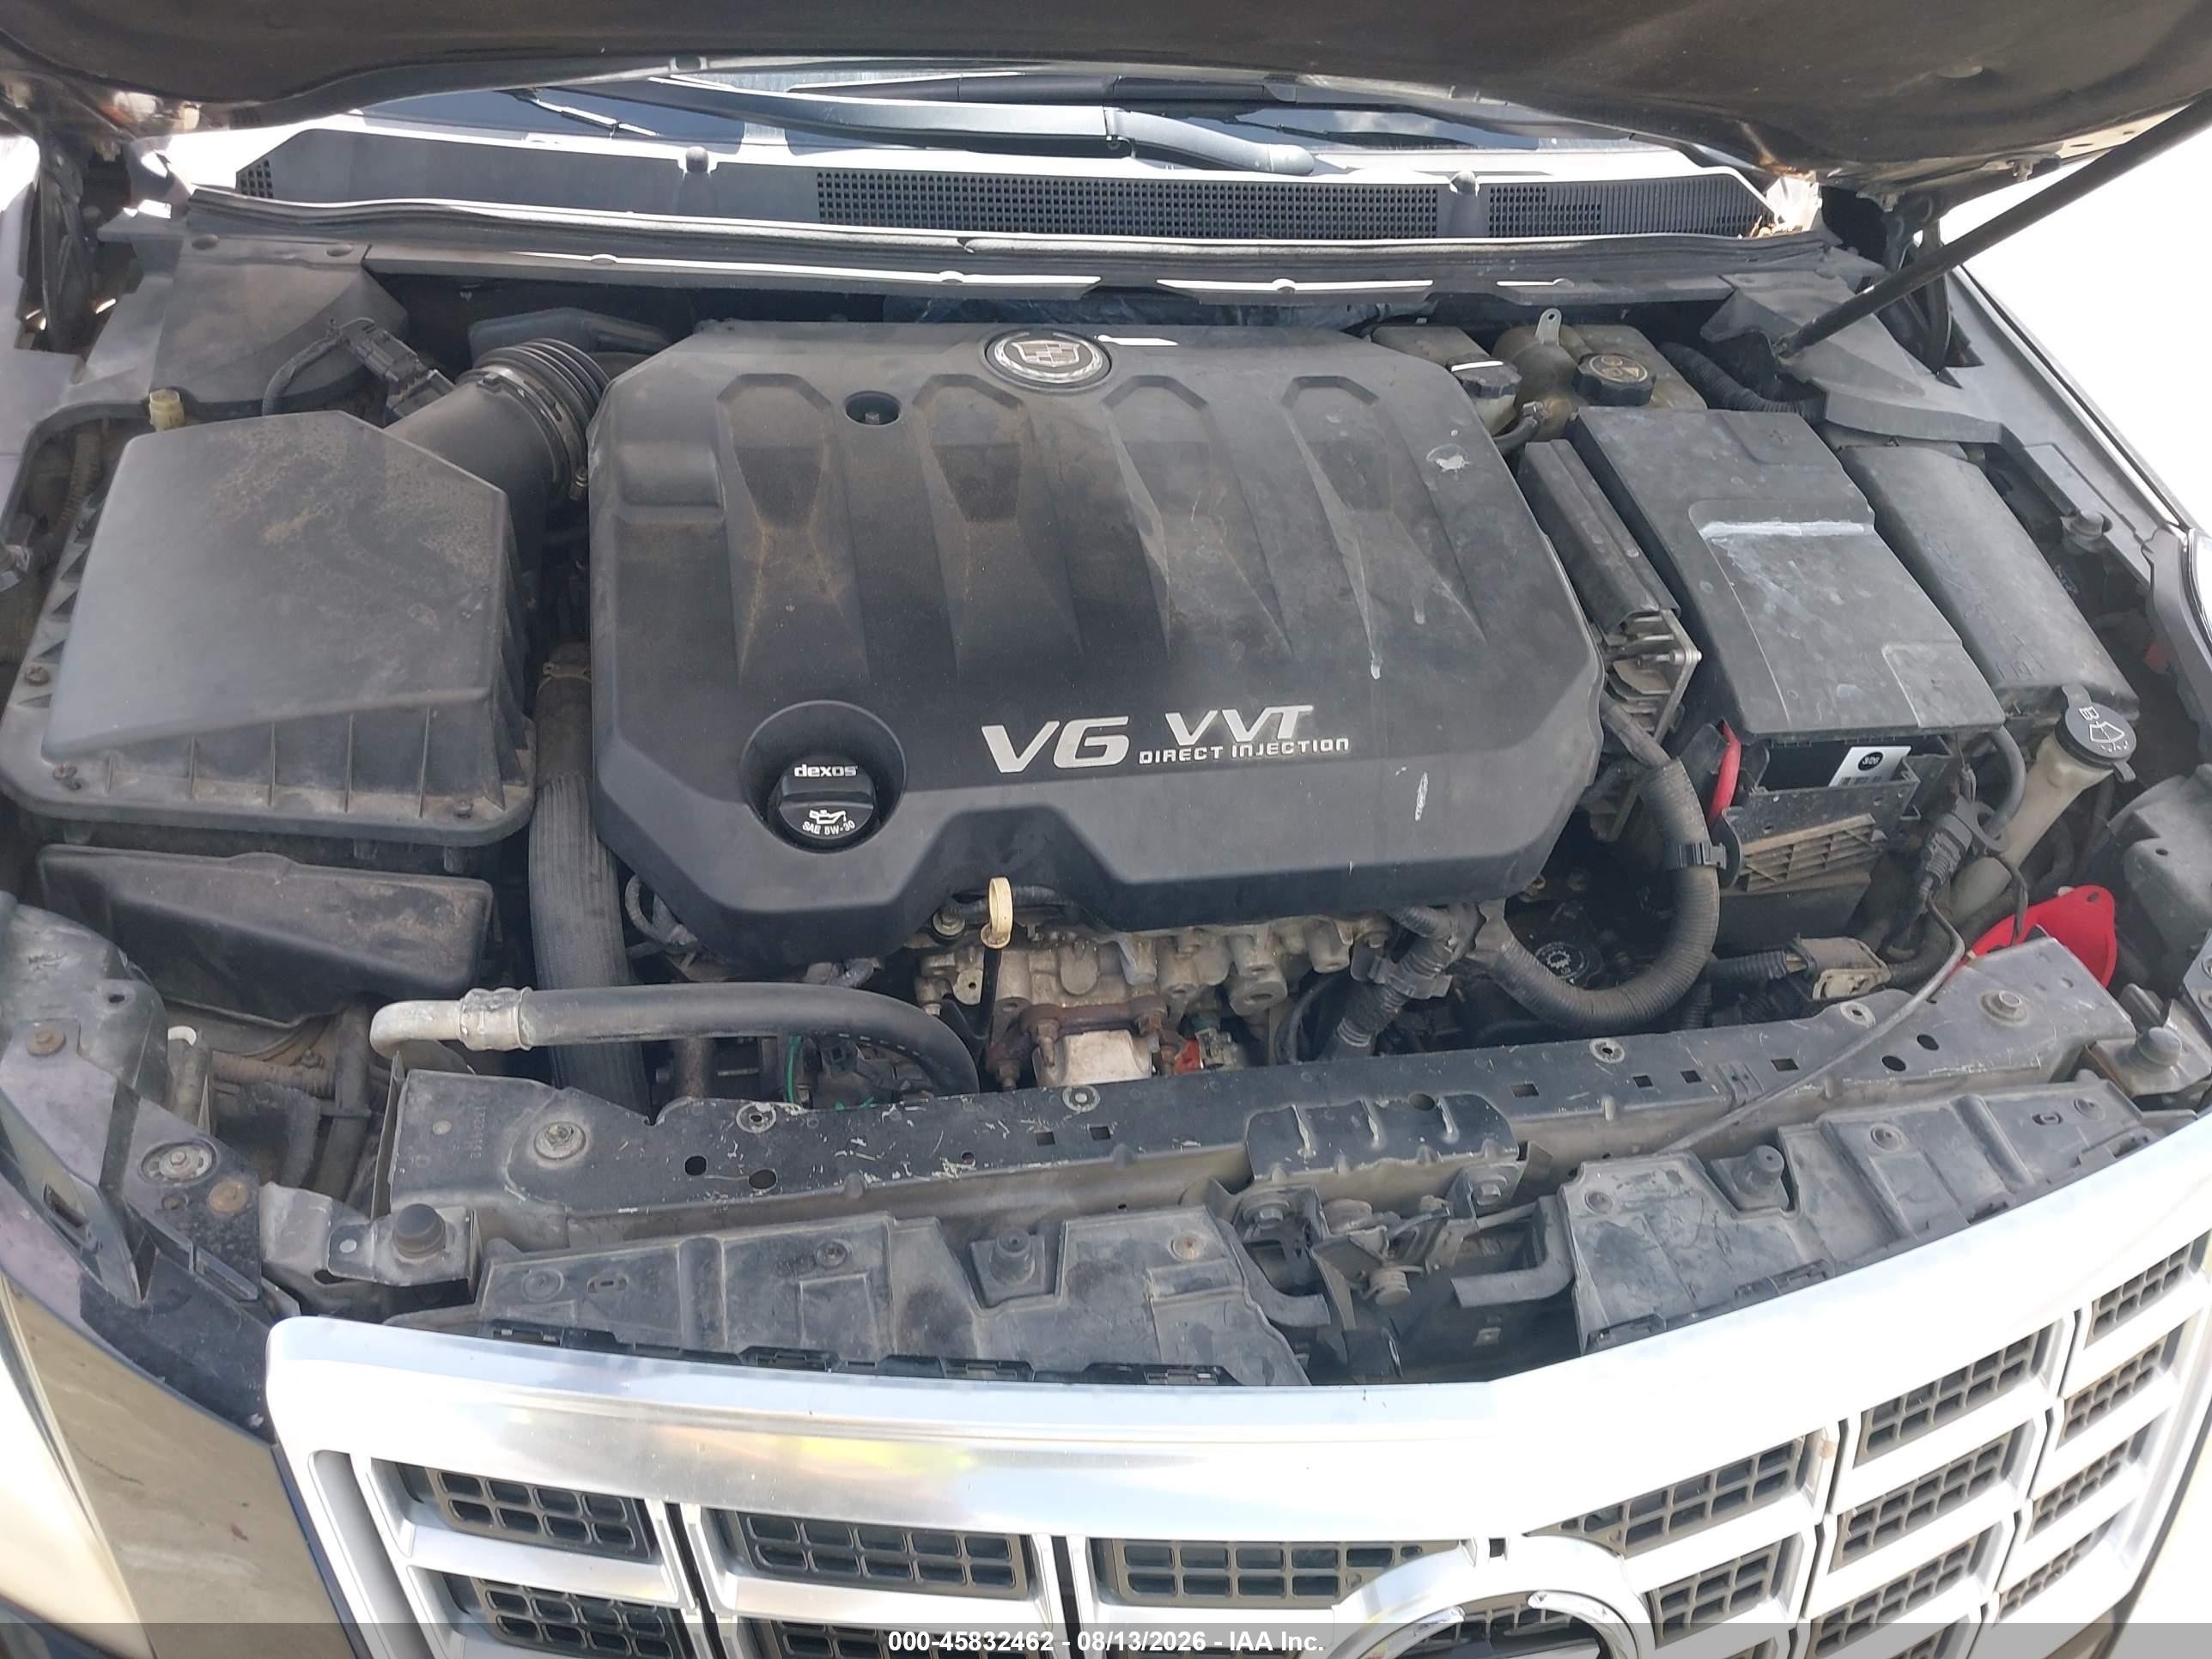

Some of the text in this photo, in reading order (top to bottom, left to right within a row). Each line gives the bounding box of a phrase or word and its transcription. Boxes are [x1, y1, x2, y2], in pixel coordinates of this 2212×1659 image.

[981, 705, 1314, 773] V6 VVT
[1139, 737, 1349, 764] DIRECT INJECTION
[794, 763, 858, 777] dexos
[802, 820, 855, 836] SAE 5W-30
